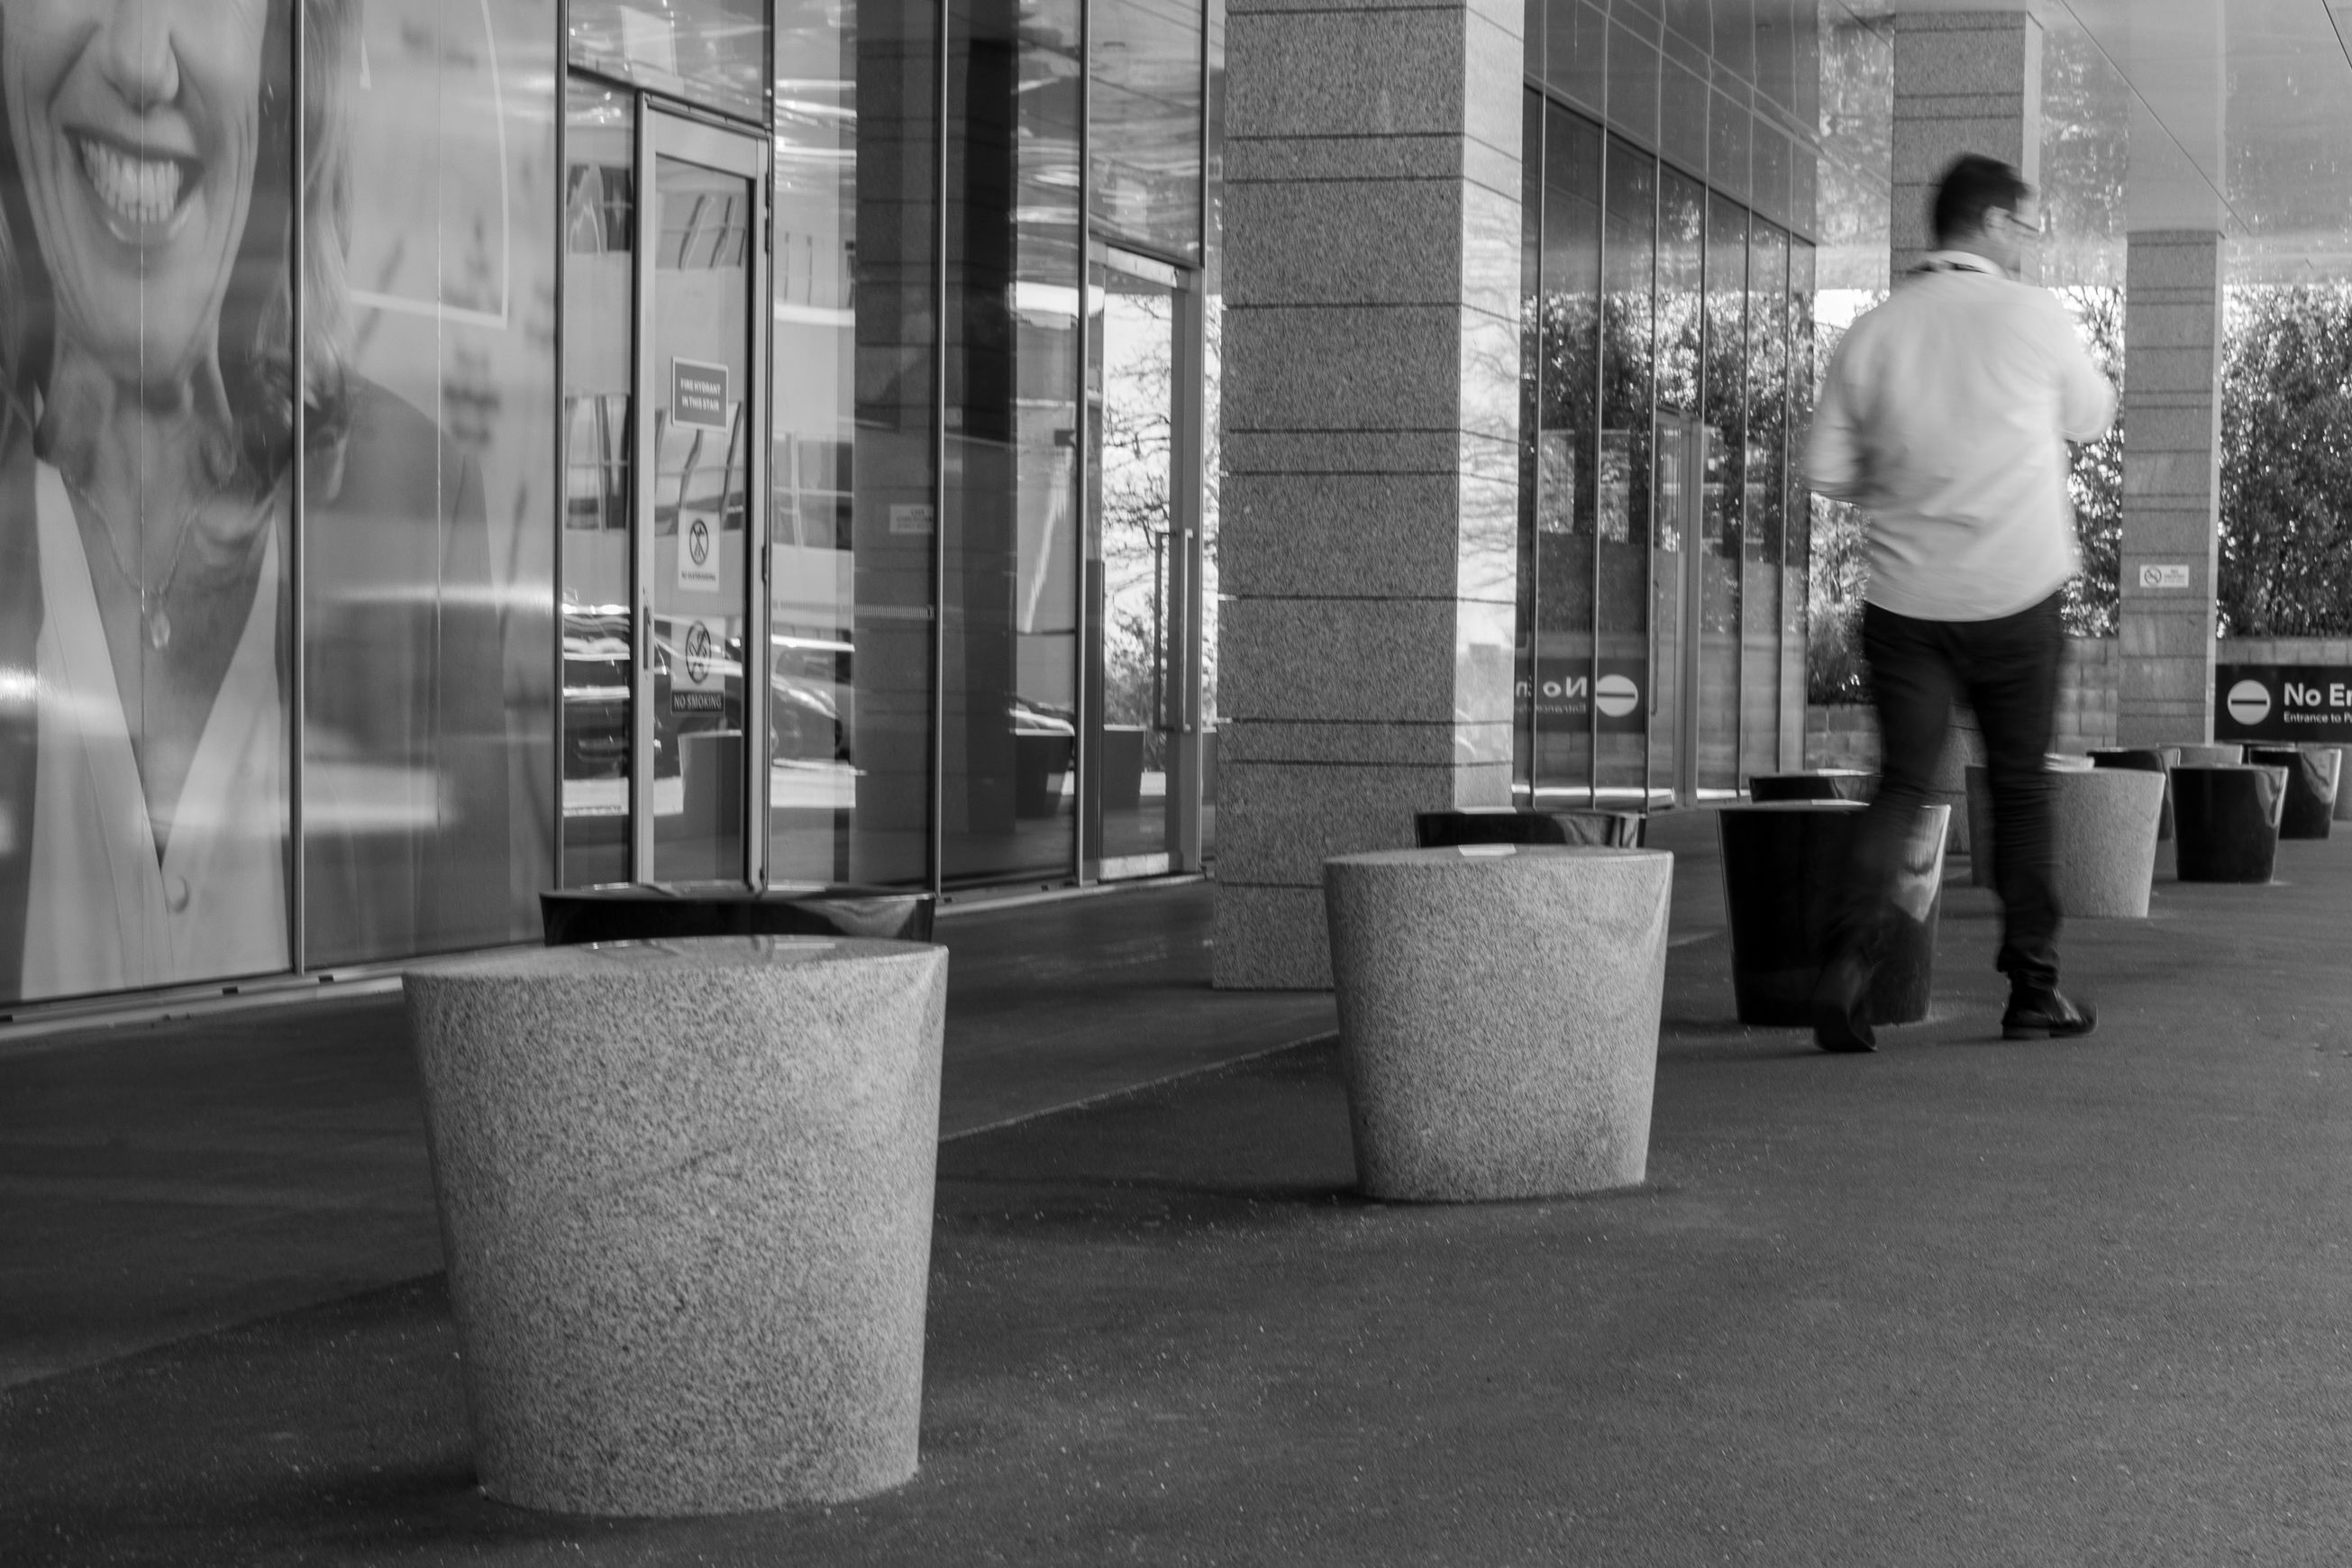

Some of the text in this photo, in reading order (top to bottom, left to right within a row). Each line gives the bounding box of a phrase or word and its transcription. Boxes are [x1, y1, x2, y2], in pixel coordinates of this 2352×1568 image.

[680, 378, 721, 396] FIRE HYDRANT
[674, 694, 721, 709] NO SMOKING
[2284, 682, 2321, 707] No
[2284, 711, 2329, 723] Entrance
[2330, 713, 2341, 724] to
